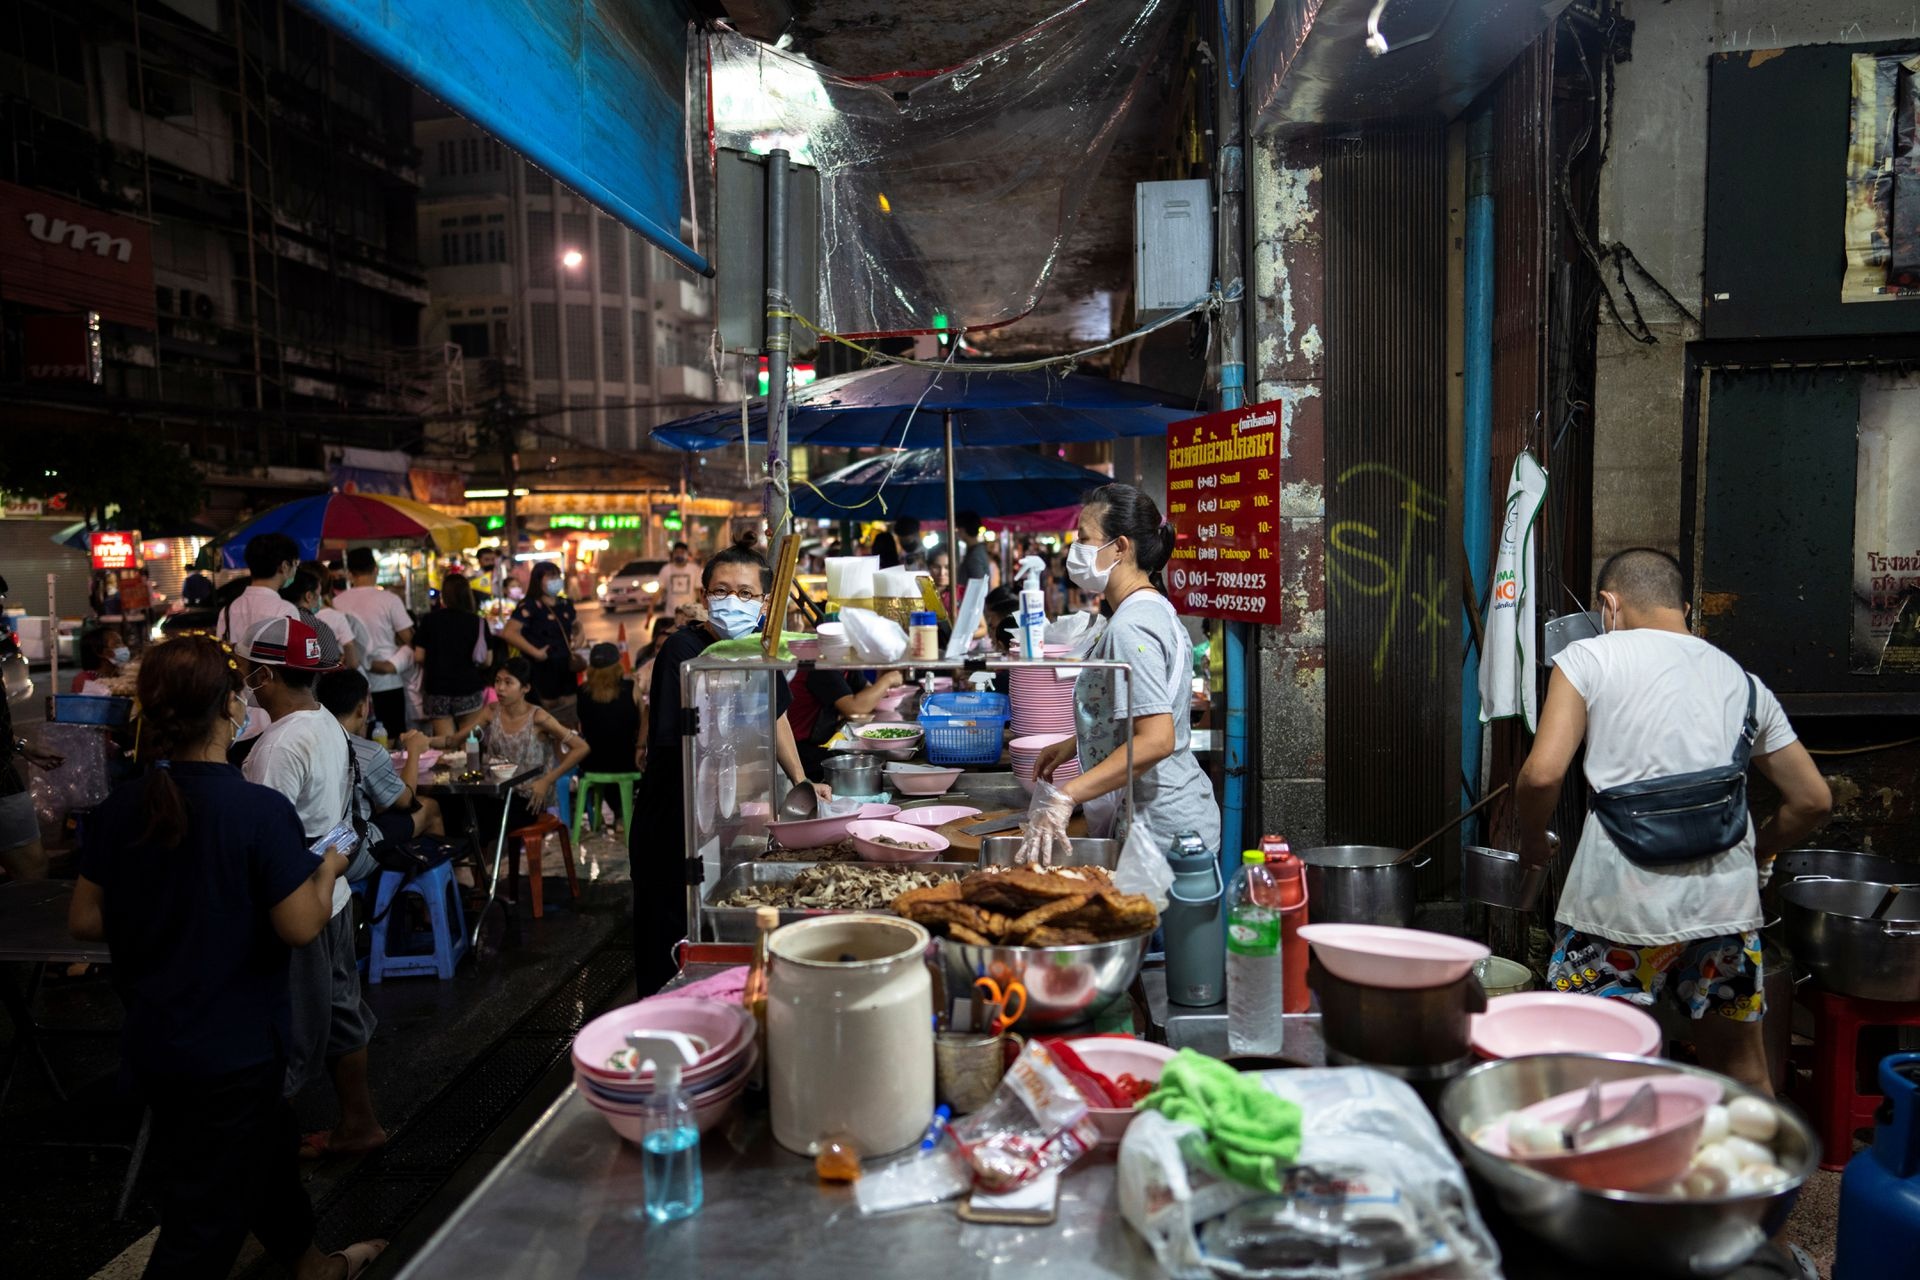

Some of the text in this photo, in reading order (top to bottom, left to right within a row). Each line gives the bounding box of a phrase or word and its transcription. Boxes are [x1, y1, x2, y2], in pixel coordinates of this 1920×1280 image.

[1220, 471, 1240, 485] Small
[1220, 498, 1241, 511] Large
[1220, 523, 1235, 537] Egg
[1189, 571, 1266, 590] 061-7824223
[1188, 592, 1266, 613] 082-6932329
